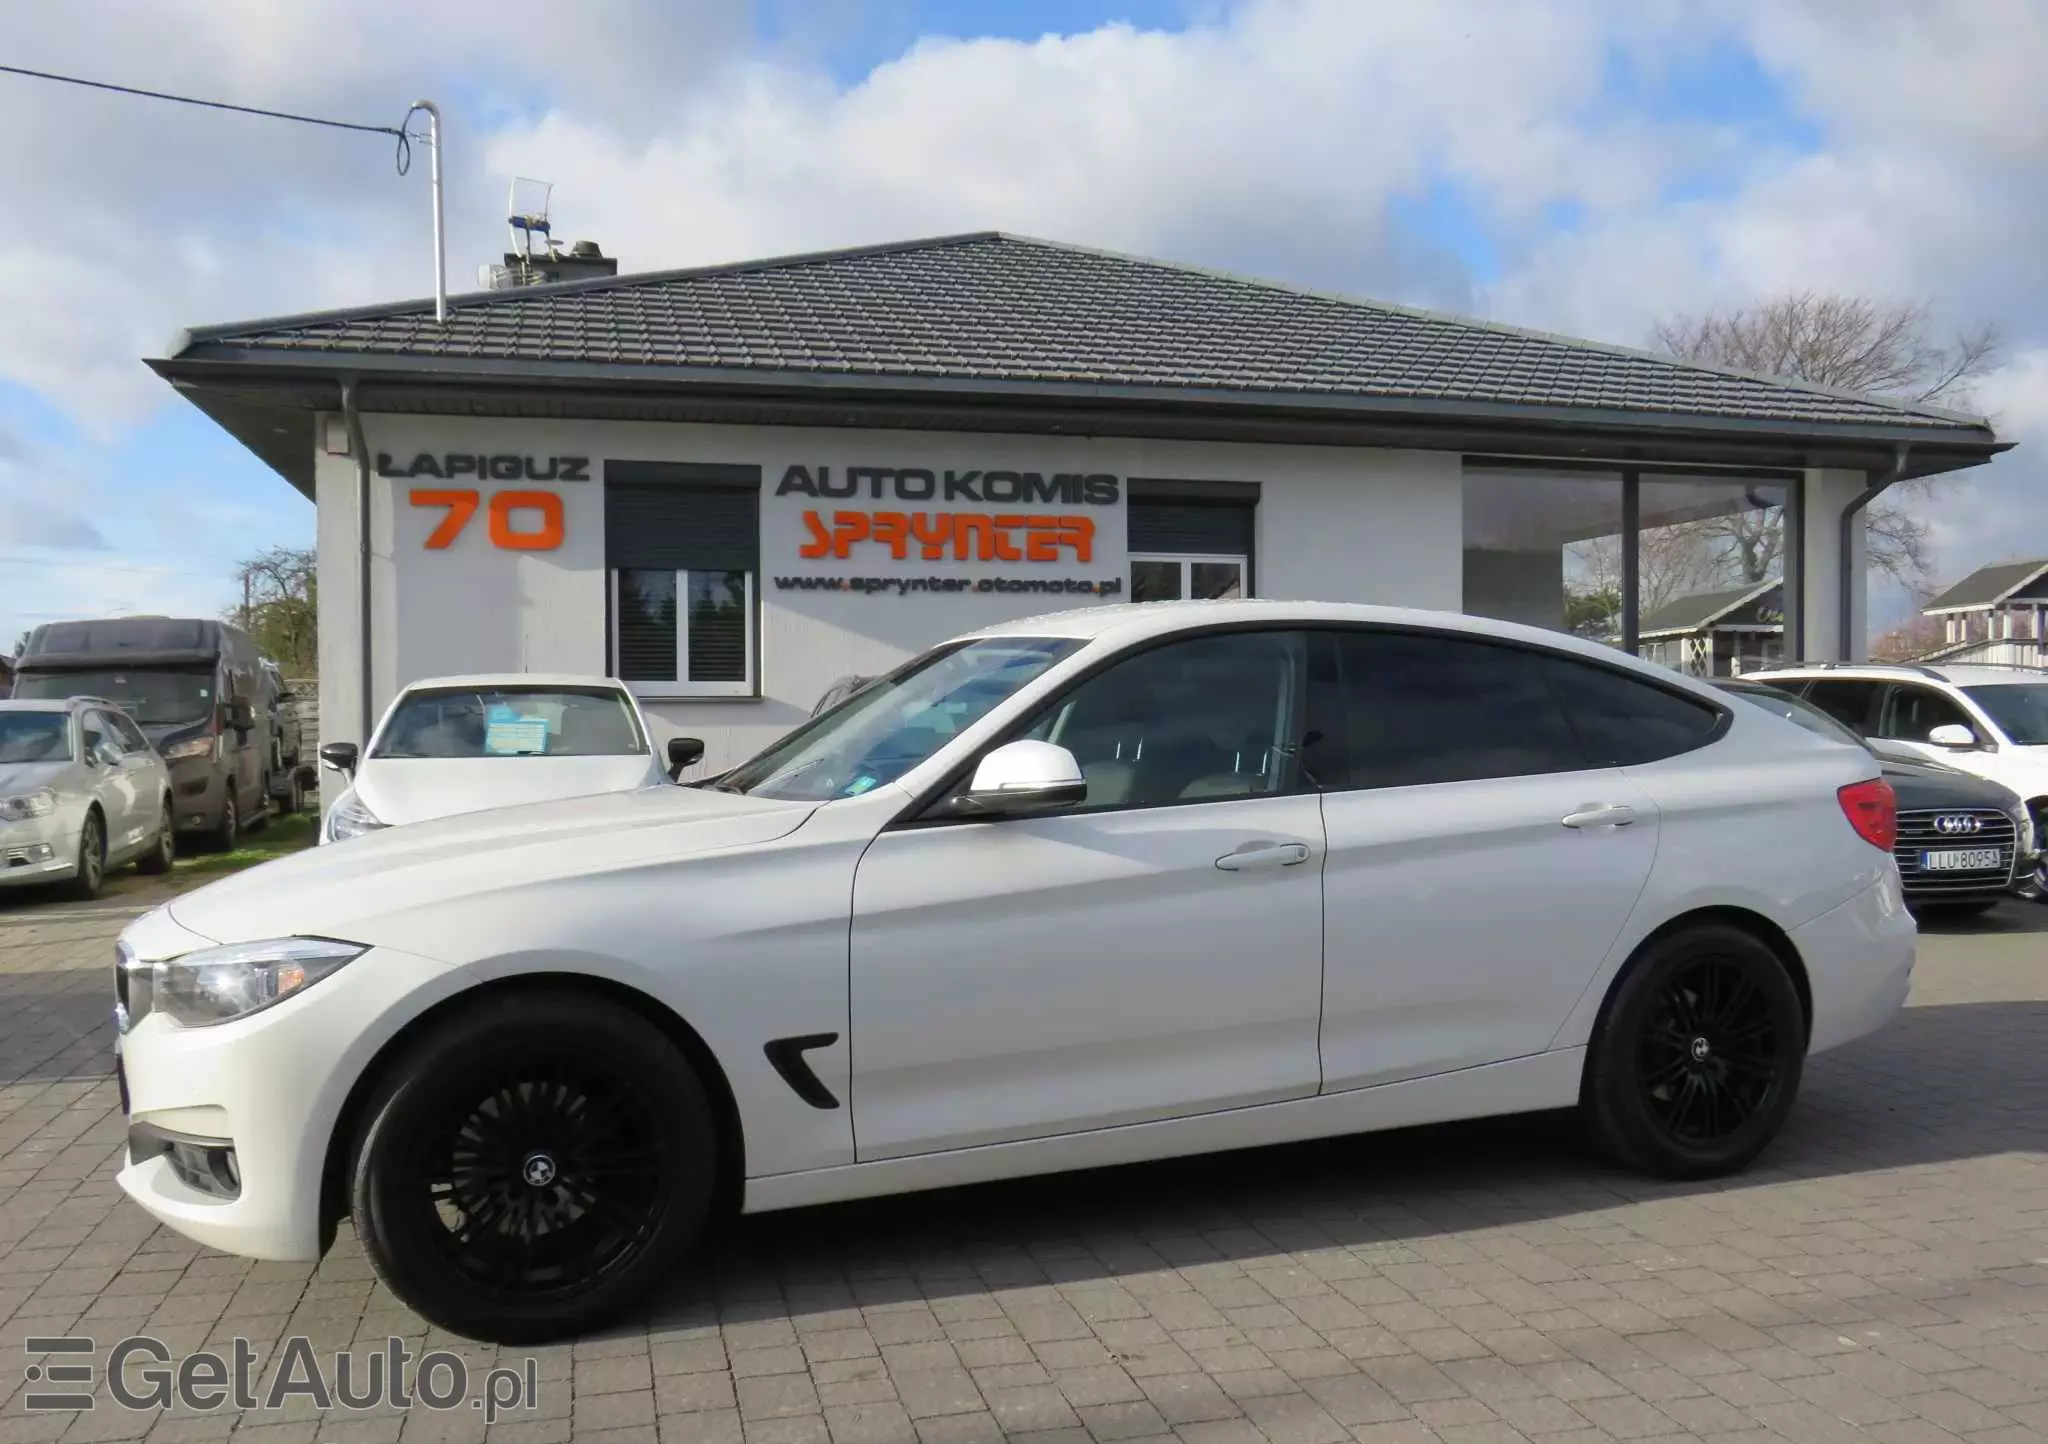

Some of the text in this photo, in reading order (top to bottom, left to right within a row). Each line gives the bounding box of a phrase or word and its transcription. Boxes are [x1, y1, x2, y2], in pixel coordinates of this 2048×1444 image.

[775, 464, 1120, 505] AUTO KOMIS
[409, 489, 565, 551] 70
[799, 510, 1096, 563] SPRYNTER
[774, 576, 1122, 596] www.sprynter.otomoto.pl
[1930, 852, 1956, 869] LLU
